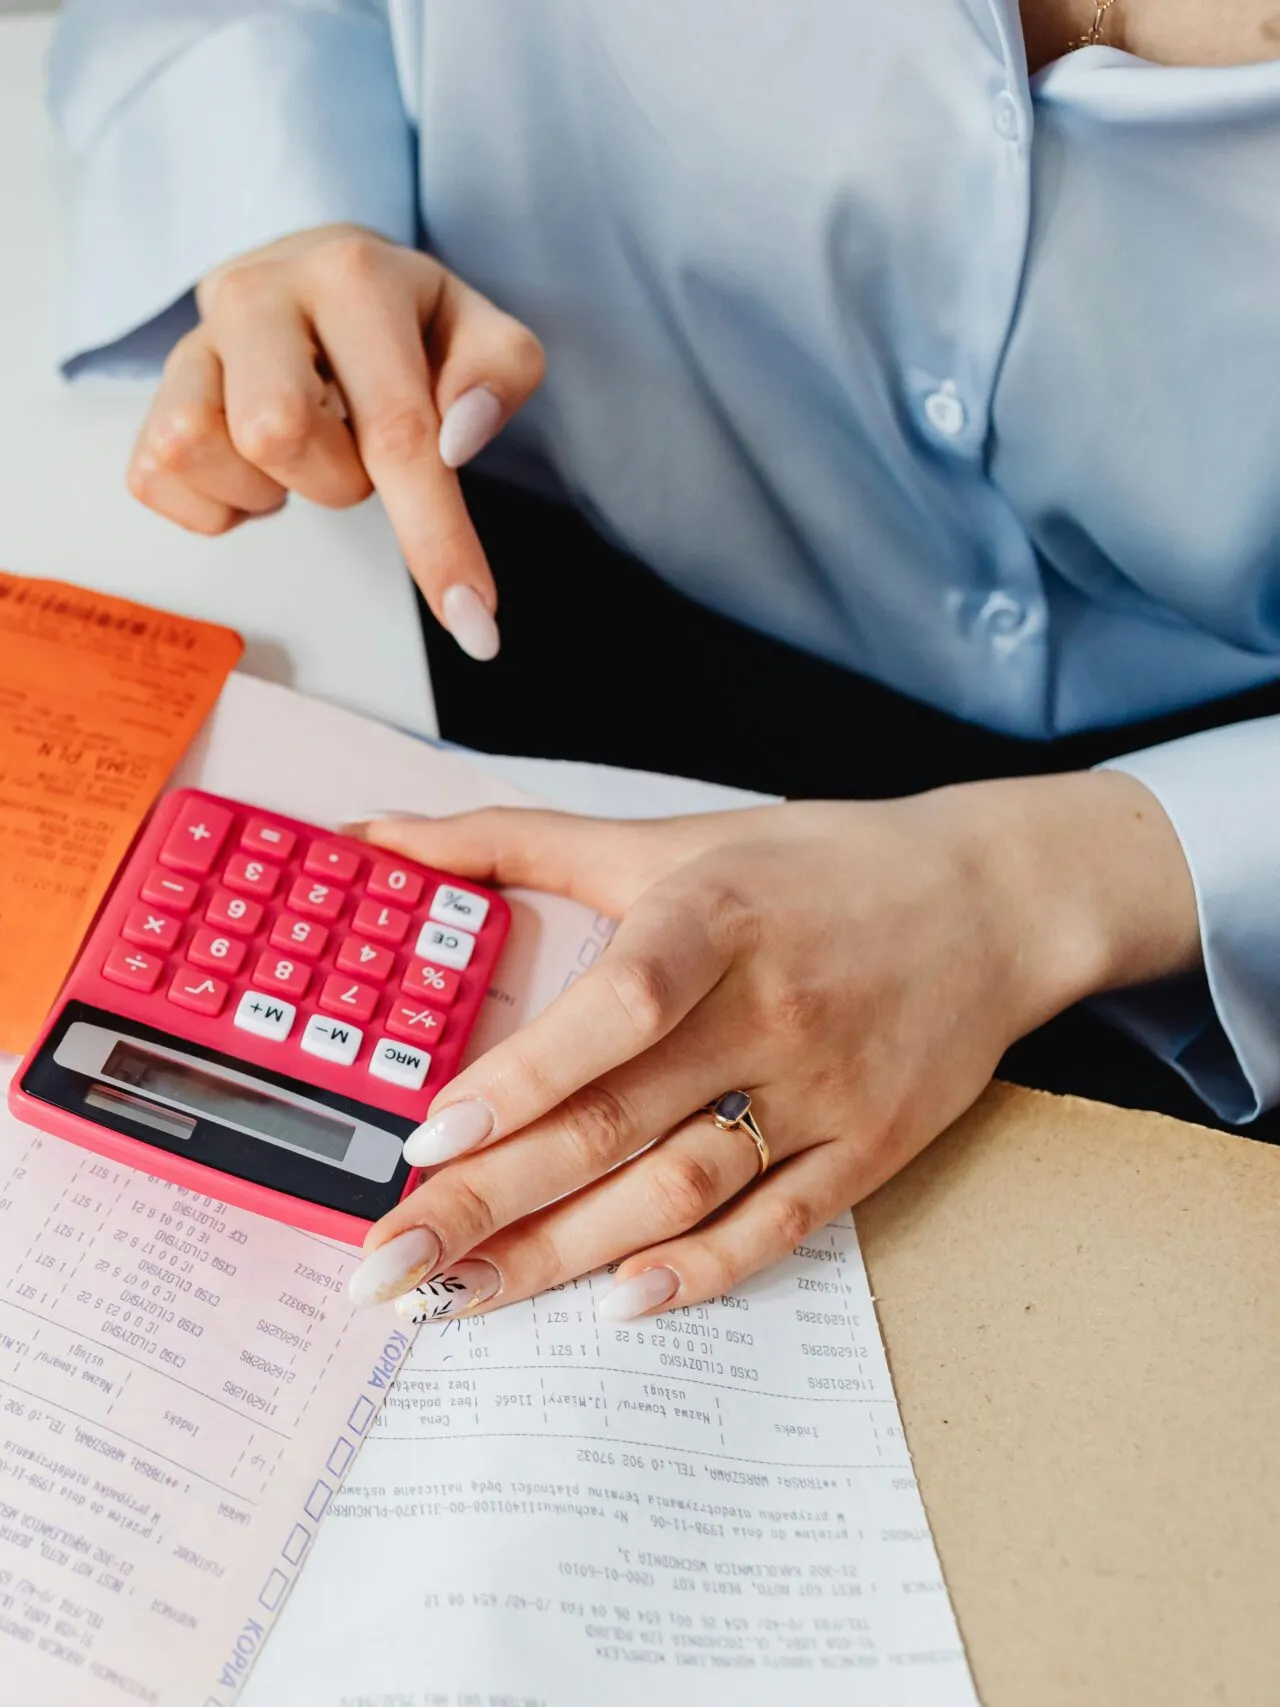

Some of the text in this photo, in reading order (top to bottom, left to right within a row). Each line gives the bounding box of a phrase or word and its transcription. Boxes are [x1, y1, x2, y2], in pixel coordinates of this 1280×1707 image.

[96, 757, 149, 779] SUMA
[245, 863, 262, 880] 3
[389, 872, 406, 888] 0
[309, 885, 328, 903] 2
[228, 900, 245, 918] 6
[378, 909, 388, 925] 1
[292, 923, 309, 941] 5
[211, 939, 229, 957] 9
[434, 934, 458, 948] CE
[360, 946, 376, 962] 4
[275, 961, 293, 979] 8
[341, 986, 358, 1003] 7
[385, 1049, 420, 1068] MRC
[89, 1164, 109, 1179] SZT
[71, 1193, 92, 1208] SZT
[132, 1201, 172, 1225] 01 21
[54, 1225, 74, 1238] SZT
[228, 1230, 247, 1245] CCF
[113, 1230, 155, 1255] 17 22
[35, 1253, 56, 1268] SZT
[212, 1257, 236, 1276] CXSQ
[95, 1259, 137, 1285] 07 22
[16, 1283, 37, 1299] SZT
[194, 1287, 220, 1306] CXSQ
[77, 1291, 121, 1316] 23 22
[718, 1293, 748, 1310] CXSQ
[547, 1312, 568, 1323] SZT
[177, 1318, 203, 1337] CXSQ
[616, 1331, 665, 1347] 23 22
[726, 1330, 753, 1345] CXSQ
[69, 1345, 104, 1366] usługi
[159, 1348, 185, 1368] CXSQ
[551, 1345, 572, 1355] SZT
[367, 1329, 409, 1390] KOPIA
[33, 1352, 113, 1394] Nazwa towaru/
[731, 1366, 758, 1381] CXSQ
[448, 1381, 469, 1392] bez
[643, 1384, 685, 1400] usługi
[5, 1399, 25, 1416] 902
[388, 1393, 471, 1410] bez podatku
[496, 1395, 532, 1406] Ilość
[549, 1395, 600, 1409] J.Miary
[420, 1415, 450, 1426] Cena
[617, 1401, 710, 1424] Nazwa towaru/
[163, 1411, 199, 1437] Indeks
[775, 1424, 818, 1438] Indeks
[4, 1441, 89, 1485] niedotrzymania
[577, 1450, 615, 1465] 97032
[622, 1454, 644, 1468] 902
[704, 1465, 768, 1486] WARSZAWA,
[60, 1487, 85, 1505] dnia
[94, 1481, 150, 1515] przypadku
[393, 1480, 828, 1523] przypadku niedotrzymania terminu płatności będą naliczane
[90, 1502, 104, 1514] do
[108, 1511, 153, 1538] przelew
[614, 1511, 848, 1541] przelew do dnia 1998-11-06 Nr
[638, 1553, 707, 1571] WSCHODNIA
[673, 1578, 695, 1591] KOT
[217, 1616, 265, 1689] KOPIA
